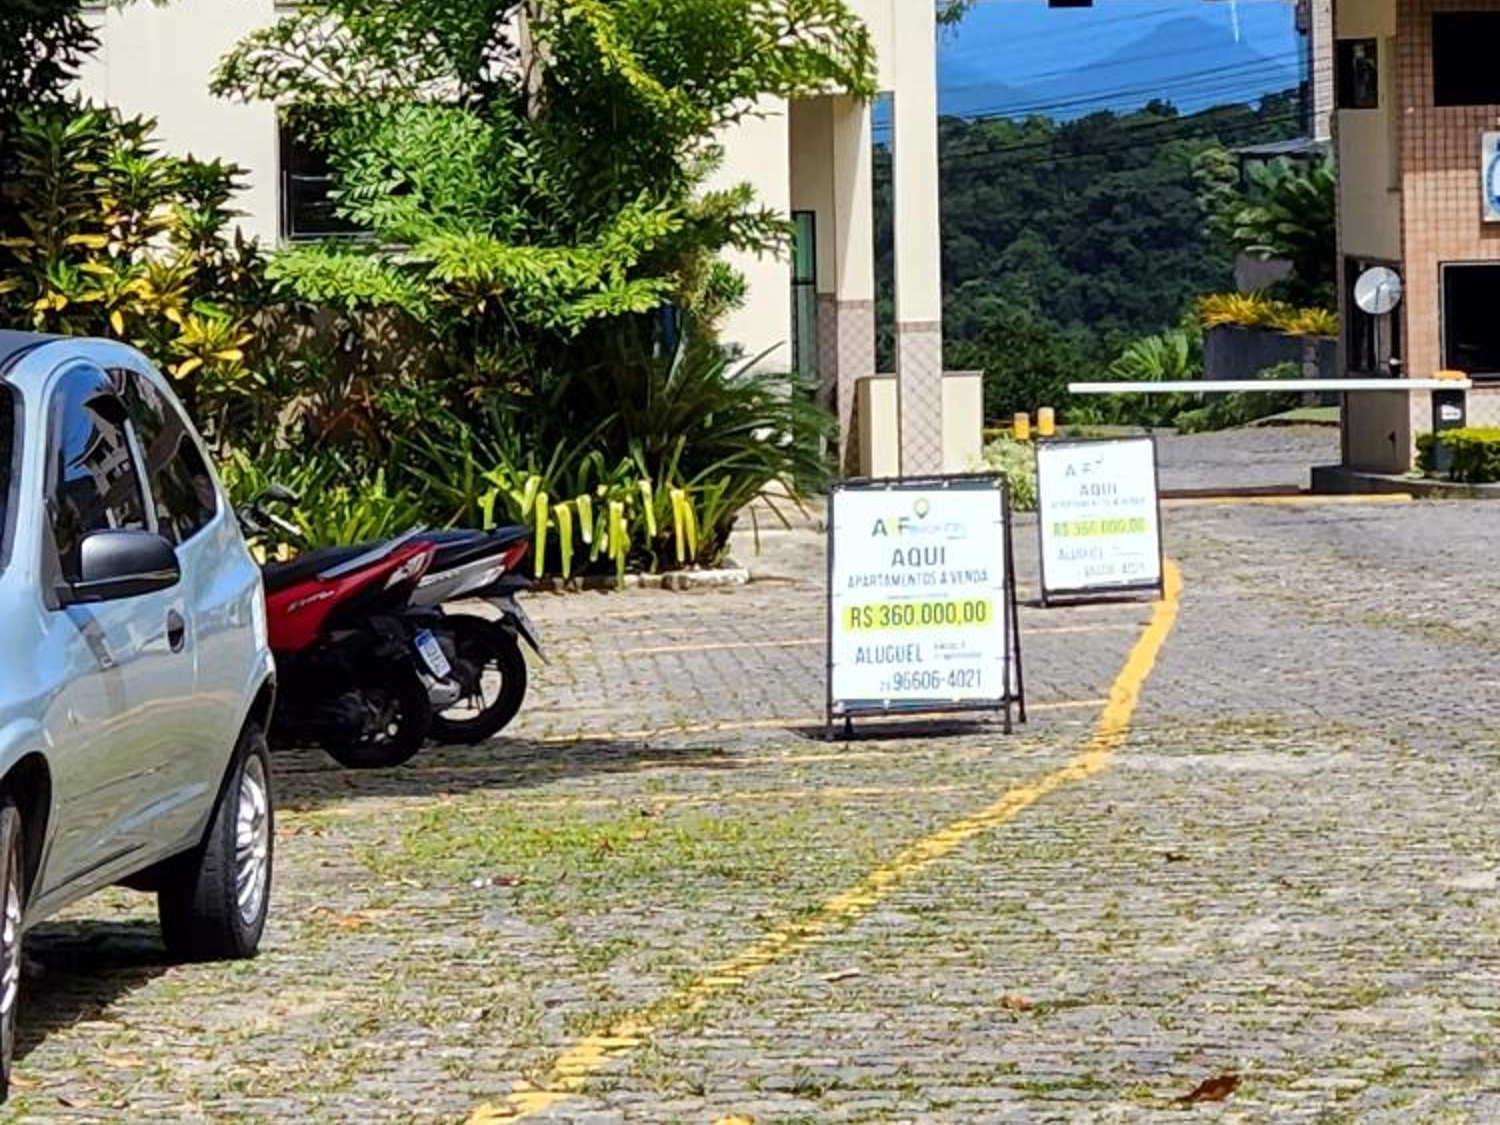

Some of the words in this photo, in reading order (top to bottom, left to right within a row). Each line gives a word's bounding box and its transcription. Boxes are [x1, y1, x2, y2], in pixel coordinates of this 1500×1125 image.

[891, 546, 946, 568] AQUI
[847, 571, 937, 588] APARTAMENTOS
[949, 569, 989, 585] VENDA
[878, 600, 987, 627] 360.000,00
[855, 642, 923, 665] ALUGUEL
